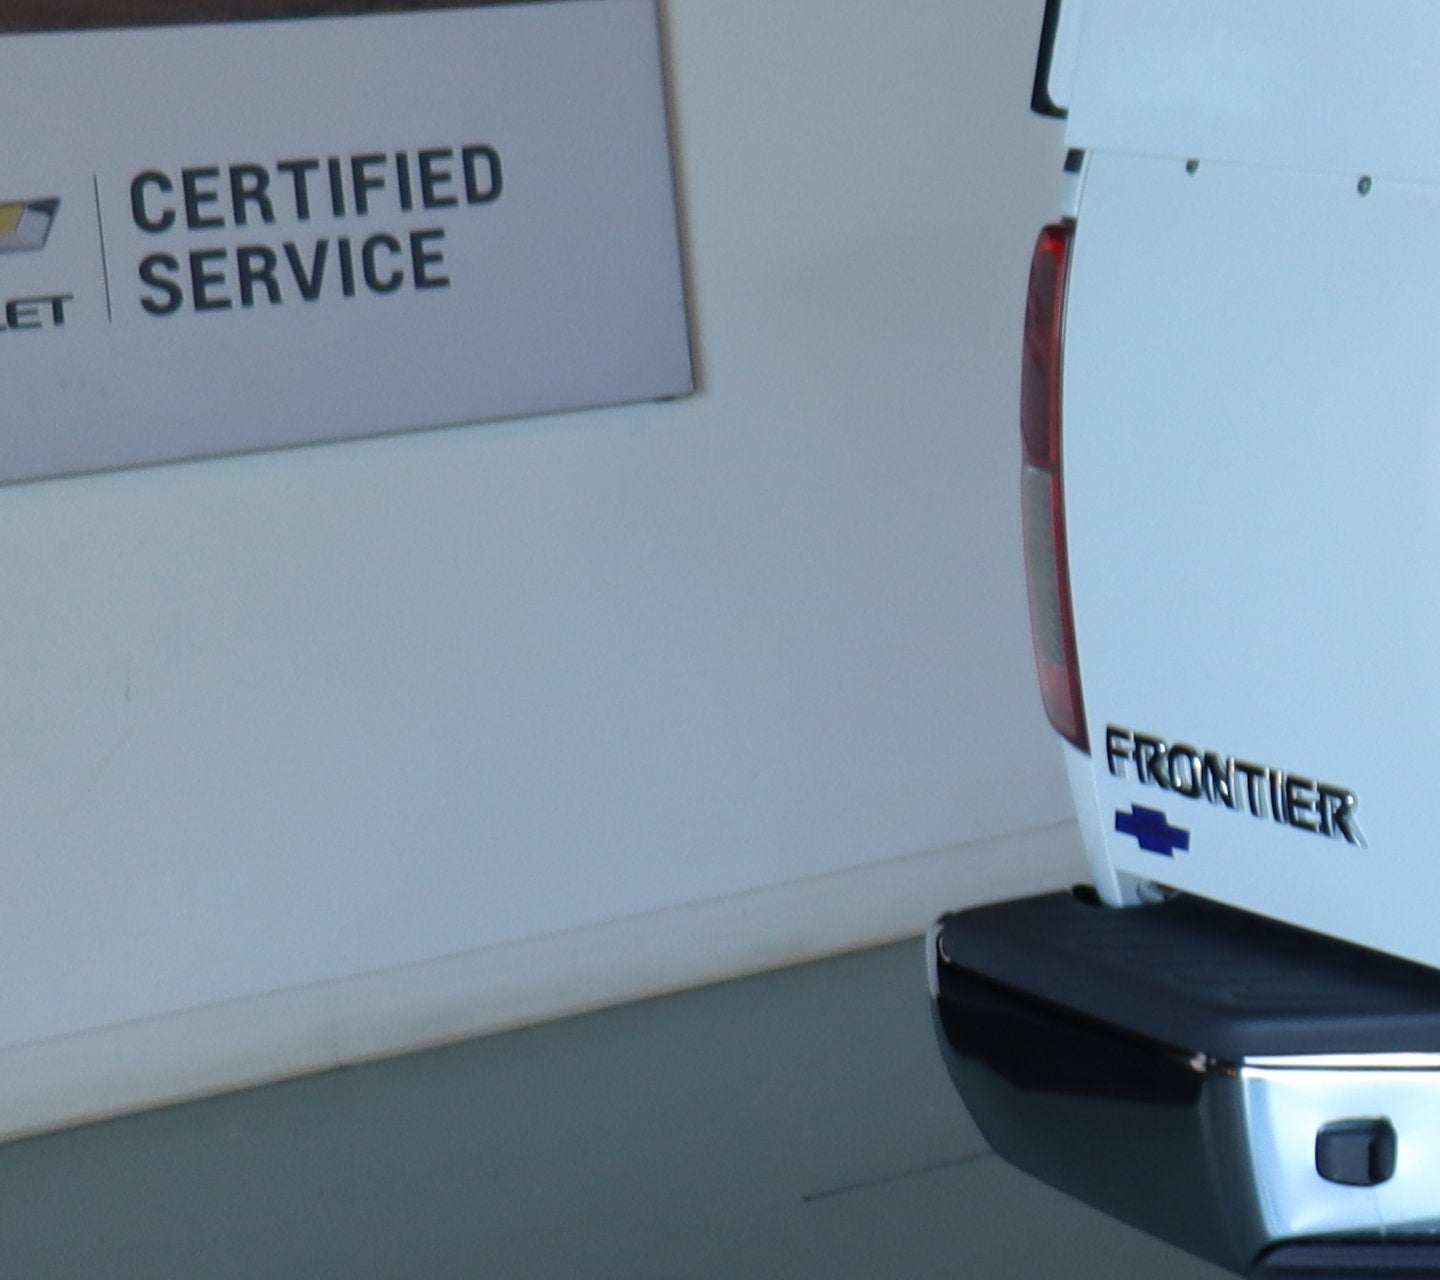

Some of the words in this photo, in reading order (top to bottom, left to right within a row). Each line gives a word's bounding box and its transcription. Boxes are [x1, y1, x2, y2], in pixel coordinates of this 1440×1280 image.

[130, 144, 503, 234] CERTIFIED
[0, 293, 74, 331] ET
[138, 228, 451, 318] SERVICE
[1106, 723, 1368, 850] FRONTIER
